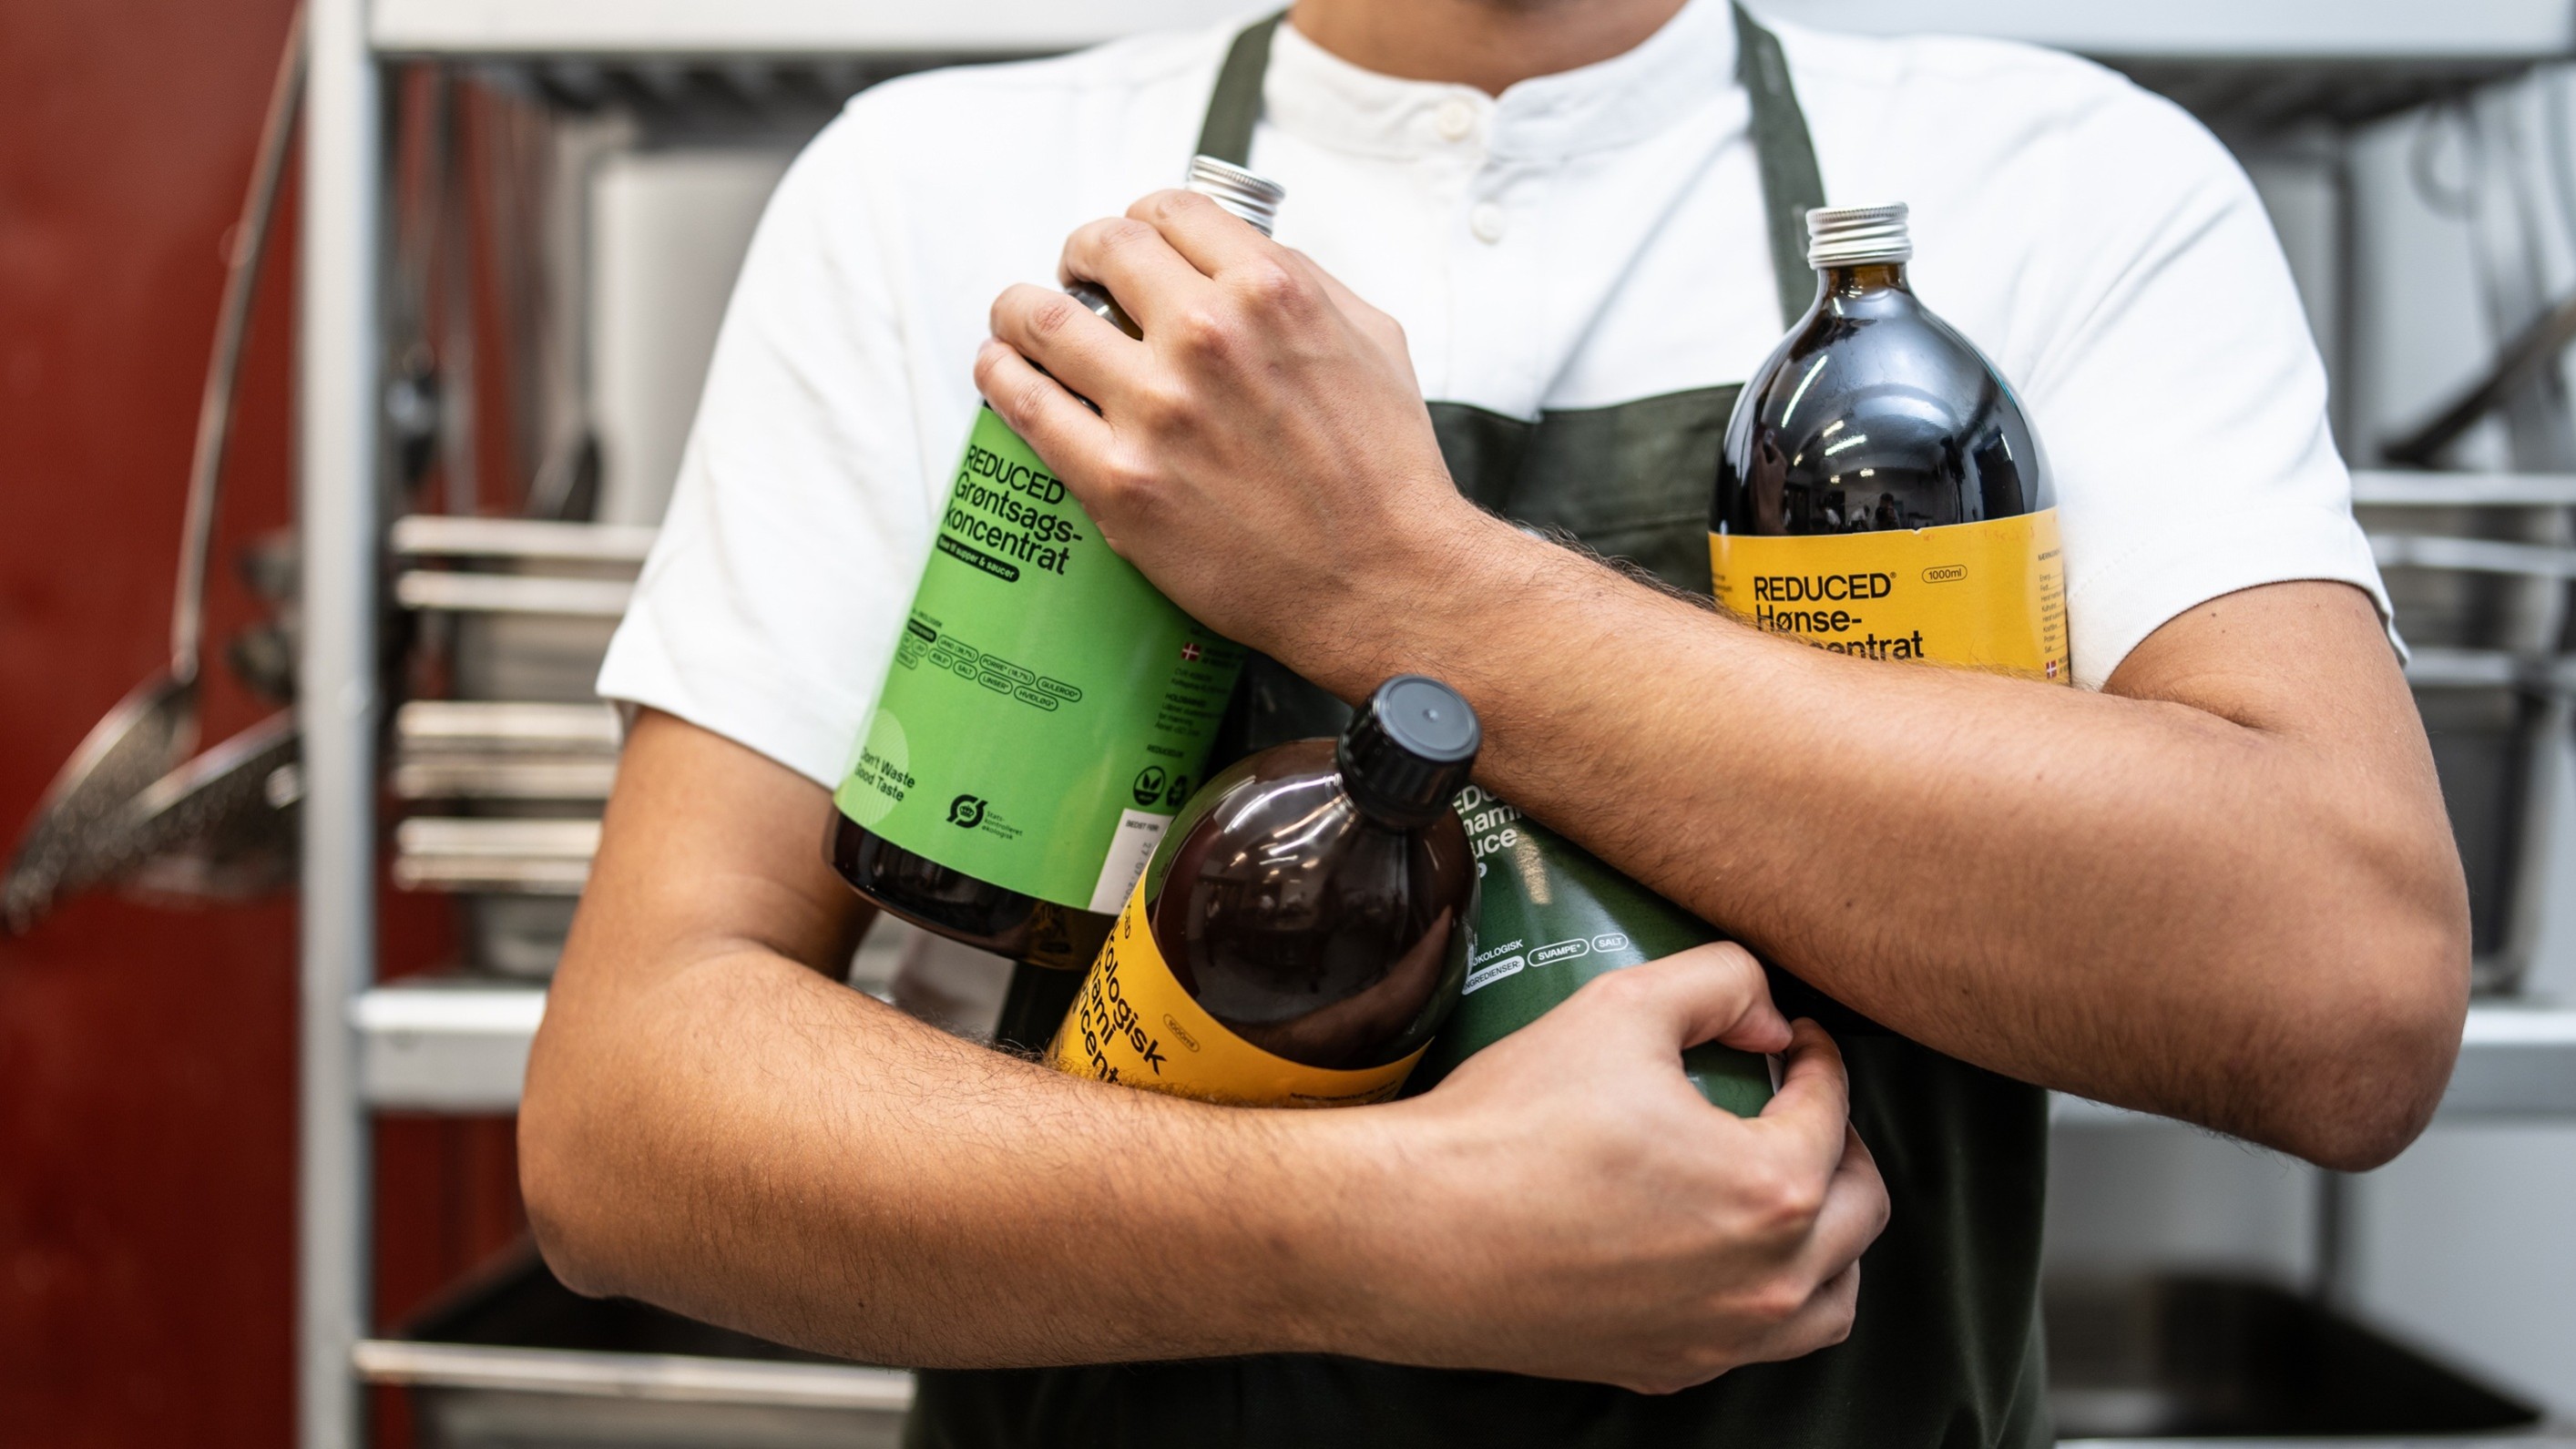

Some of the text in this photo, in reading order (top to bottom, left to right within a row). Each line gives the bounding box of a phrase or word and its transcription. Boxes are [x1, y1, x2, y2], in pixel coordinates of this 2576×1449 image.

[964, 444, 1066, 505] REDUCED
[955, 471, 1083, 543] Grøntsags-
[944, 499, 1070, 576] koncentrat
[986, 561, 1015, 578] saucer
[1927, 567, 1962, 580] 1000ml
[1755, 604, 1863, 633] Hønse-
[875, 776, 905, 802] Taste
[880, 759, 916, 790] Waste
[1470, 828, 1518, 860] uce
[1598, 937, 1623, 948] SALT
